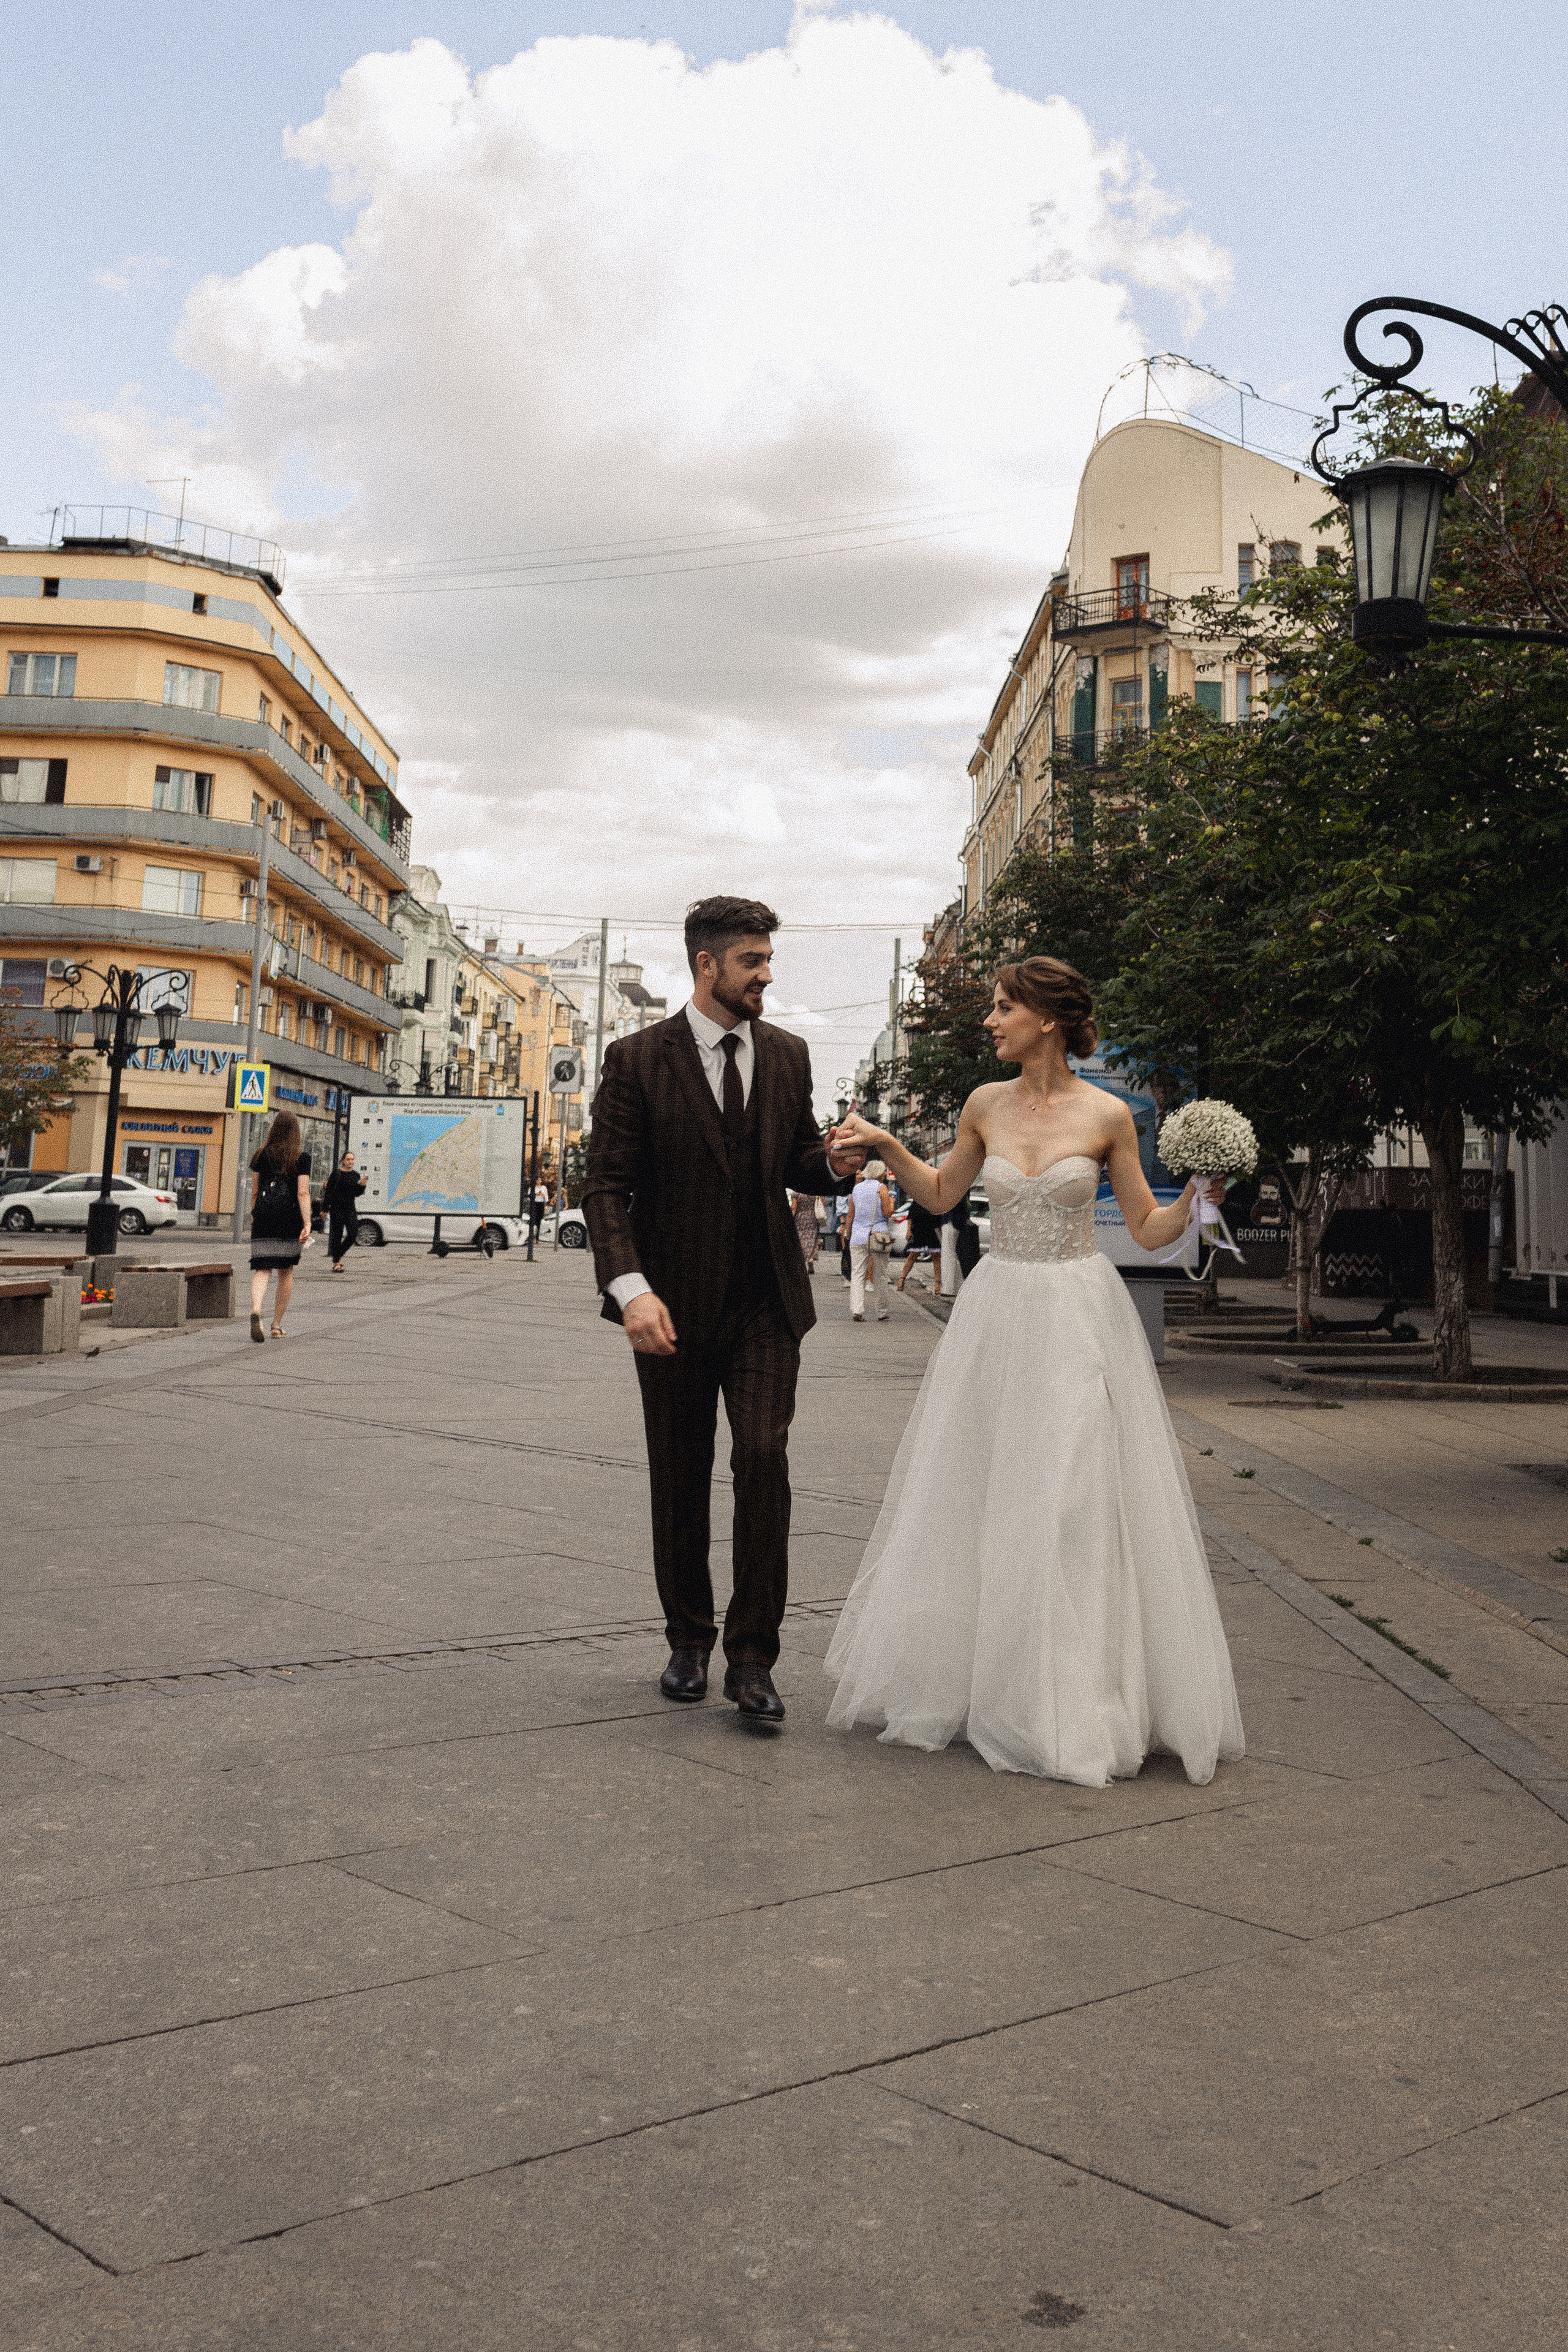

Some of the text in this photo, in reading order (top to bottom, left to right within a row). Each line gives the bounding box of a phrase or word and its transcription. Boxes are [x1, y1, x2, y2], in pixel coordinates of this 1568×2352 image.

[1408, 1170, 1486, 1189] ЗАКИ
[1461, 1194, 1487, 1210] ФЕ
[1095, 1208, 1124, 1218] ГОРДО
[1237, 1227, 1277, 1242] BOOZER
